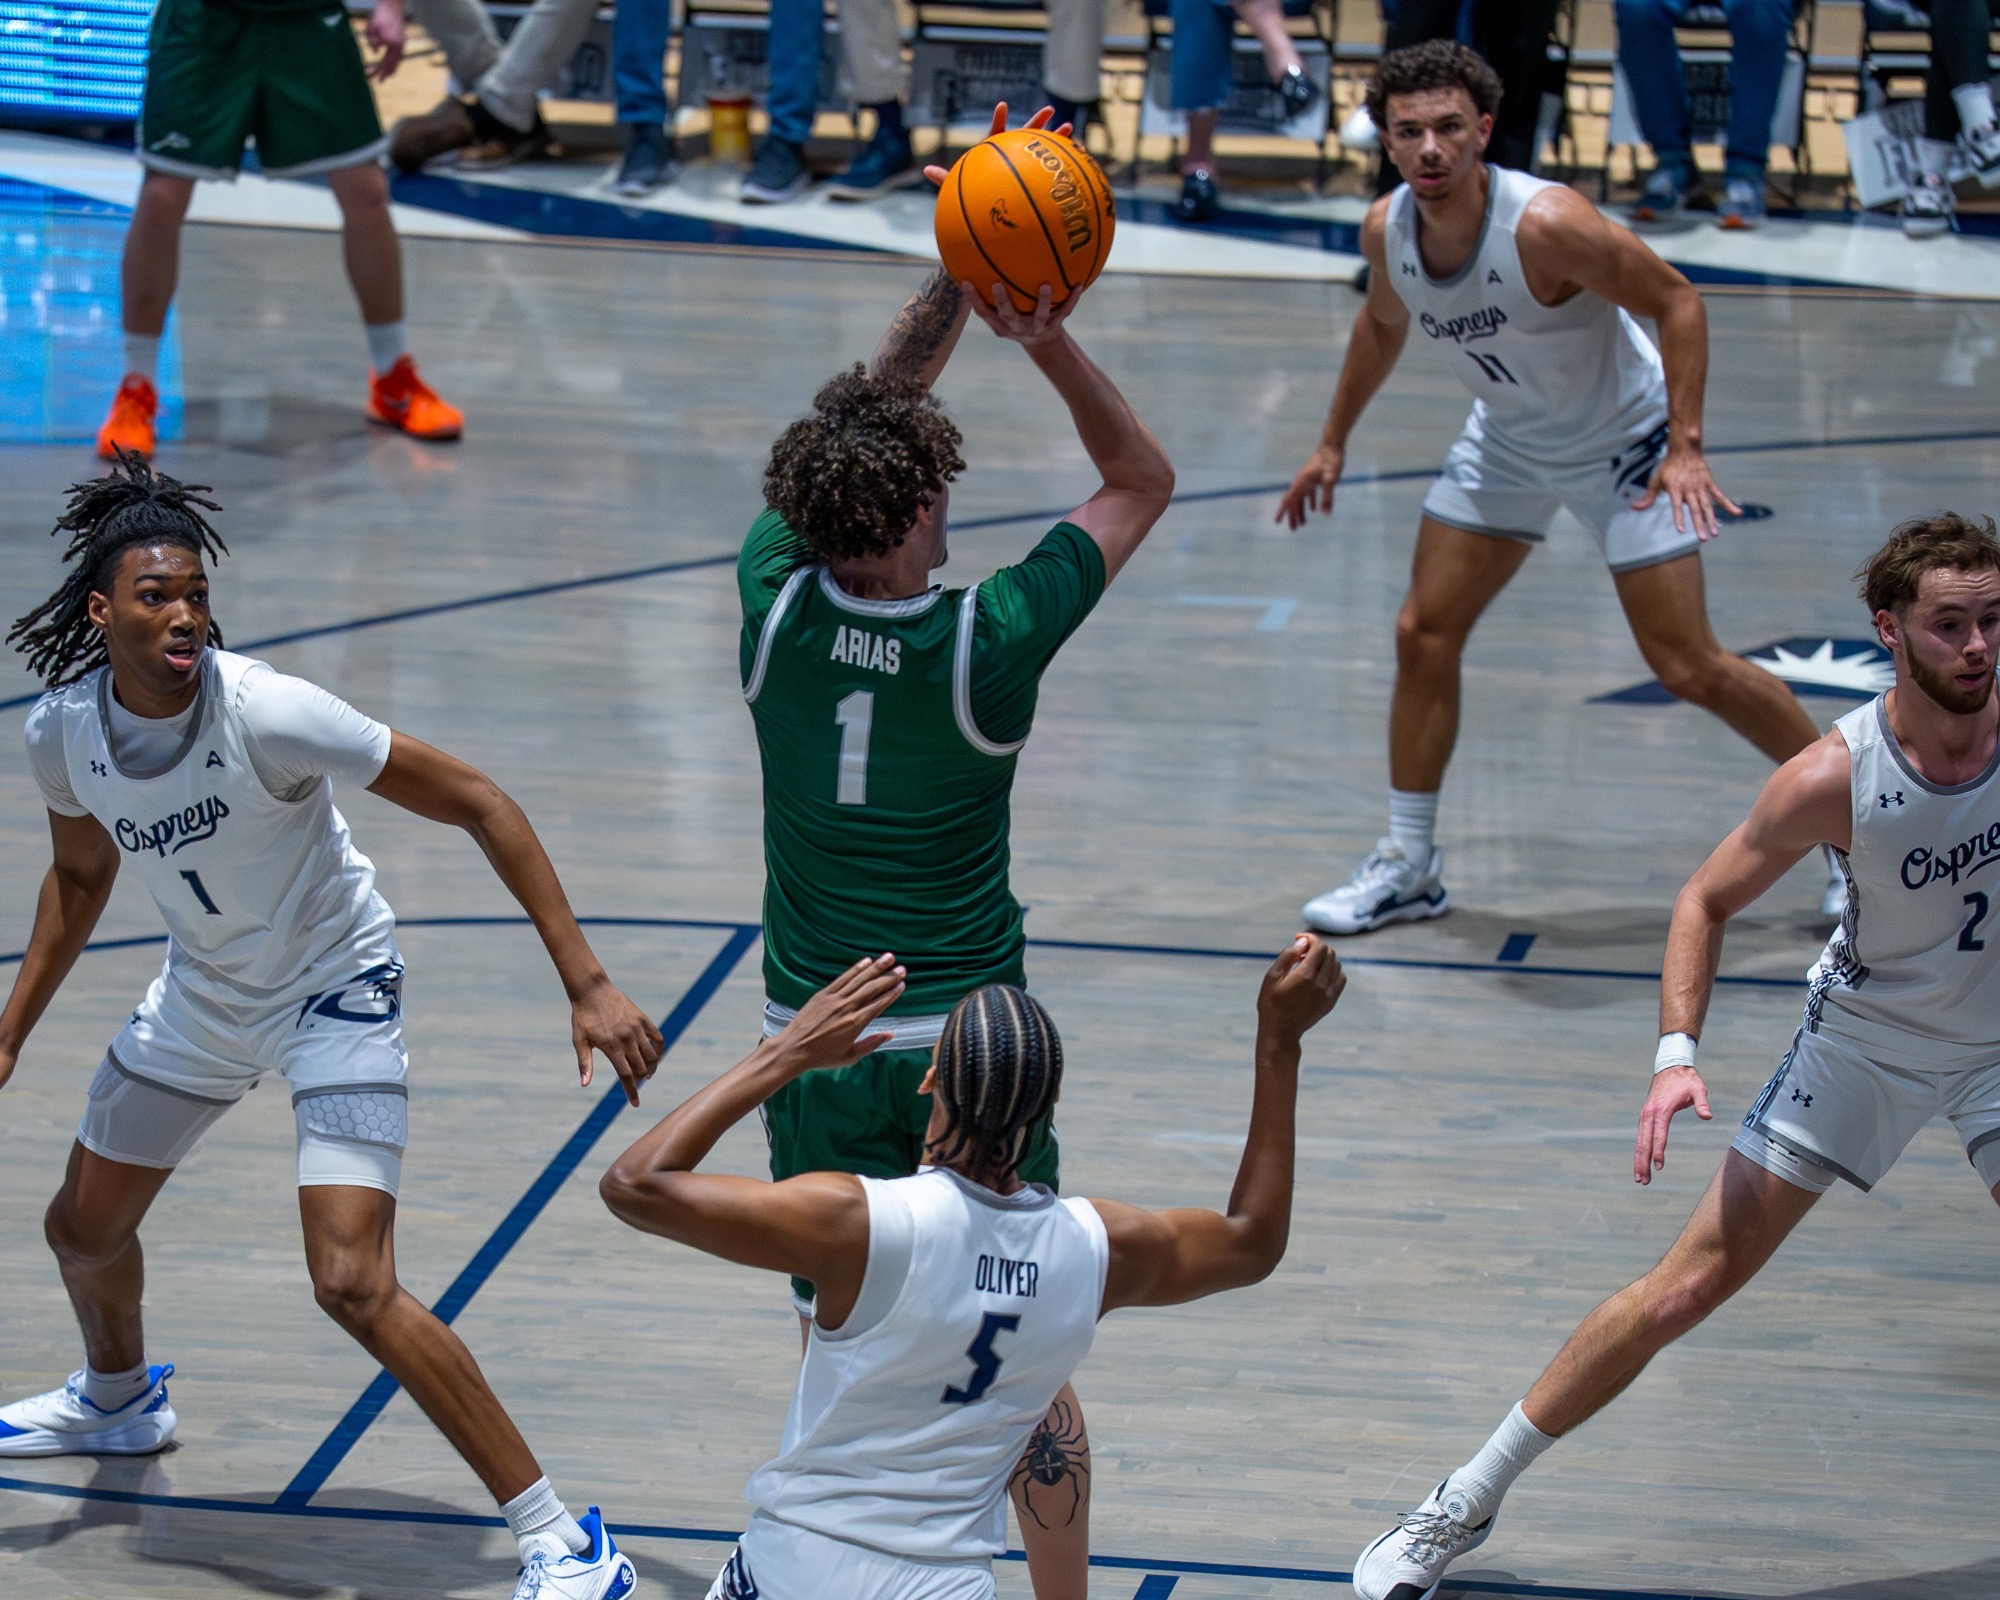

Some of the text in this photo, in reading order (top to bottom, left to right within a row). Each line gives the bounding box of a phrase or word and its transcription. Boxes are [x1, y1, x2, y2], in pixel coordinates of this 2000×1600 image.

[1025, 138, 1092, 254] Wilson
[1420, 306, 1508, 344] Ospreys
[1465, 350, 1519, 386] 11
[830, 625, 901, 675] ARIAS
[835, 690, 874, 805] 1
[115, 795, 230, 859] Ospreys
[1901, 821, 2000, 890] Ospre
[179, 870, 223, 915] 1
[1957, 891, 1989, 952] 2
[975, 1254, 1039, 1298] OLIVER
[940, 1311, 1022, 1404] 5
